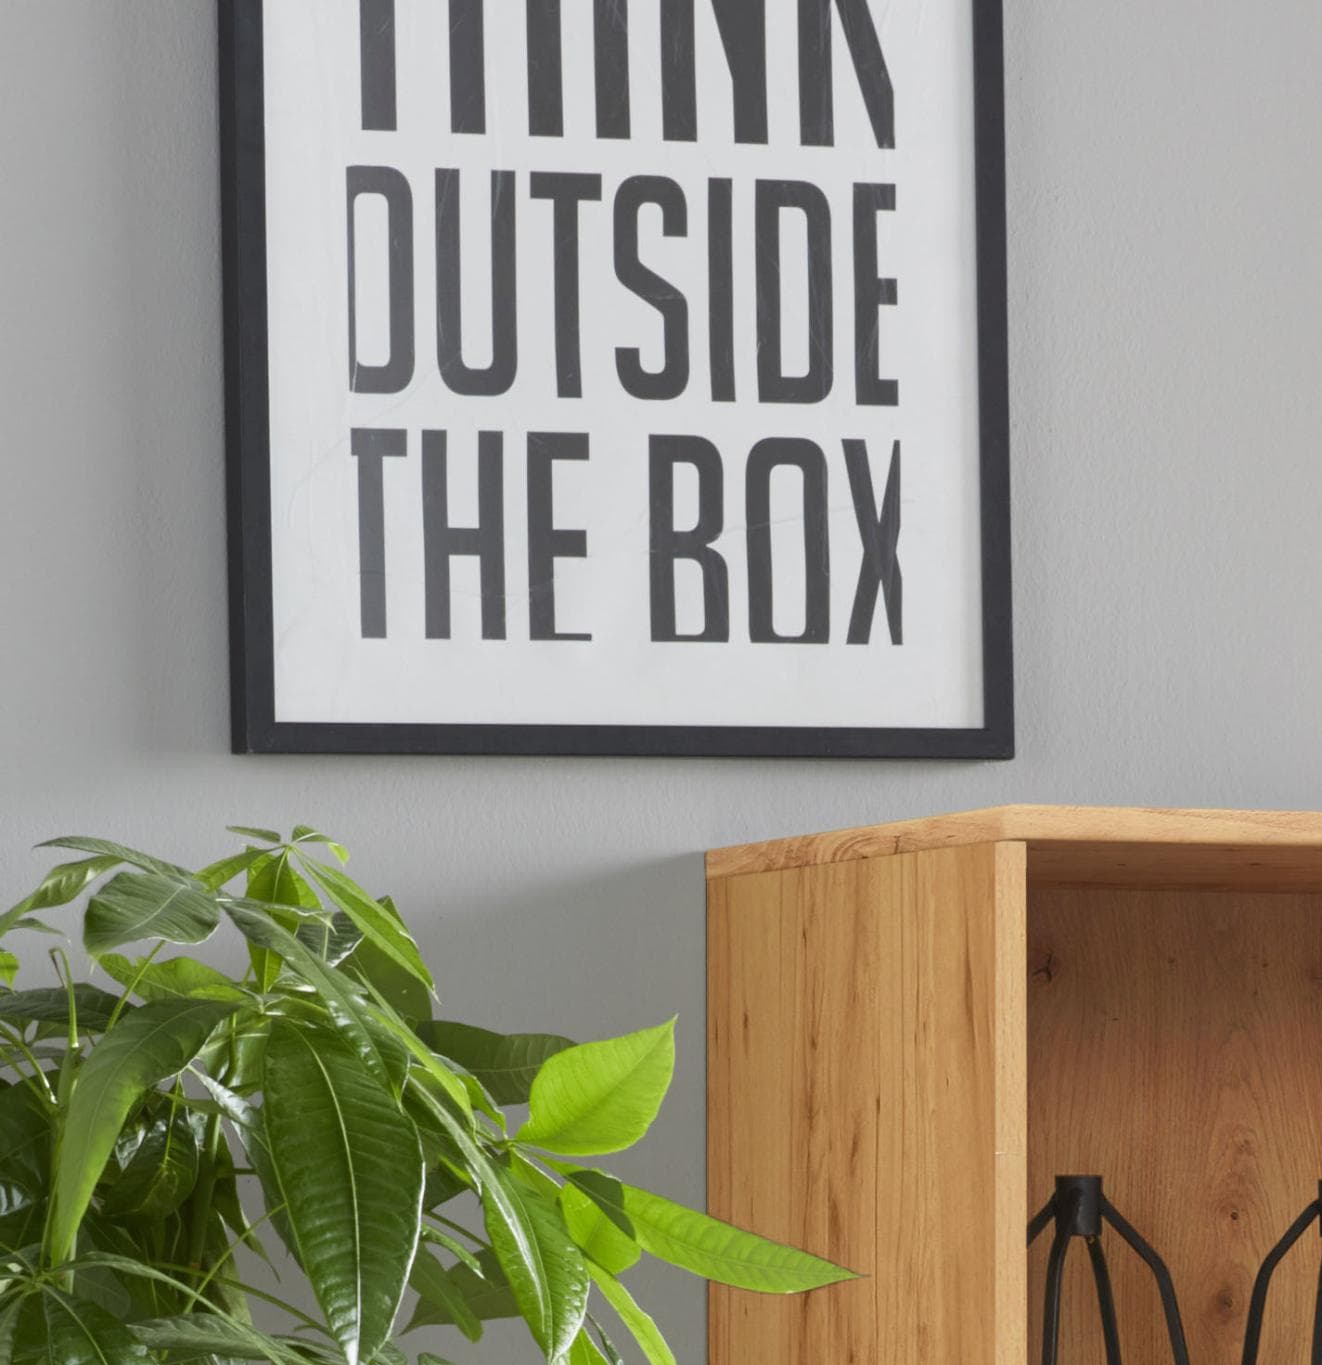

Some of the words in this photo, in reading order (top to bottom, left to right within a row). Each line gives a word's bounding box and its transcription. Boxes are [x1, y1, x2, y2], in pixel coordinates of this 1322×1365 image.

[346, 165, 899, 406] OUTSIDE
[350, 428, 592, 641] THE
[648, 434, 903, 646] BOX
